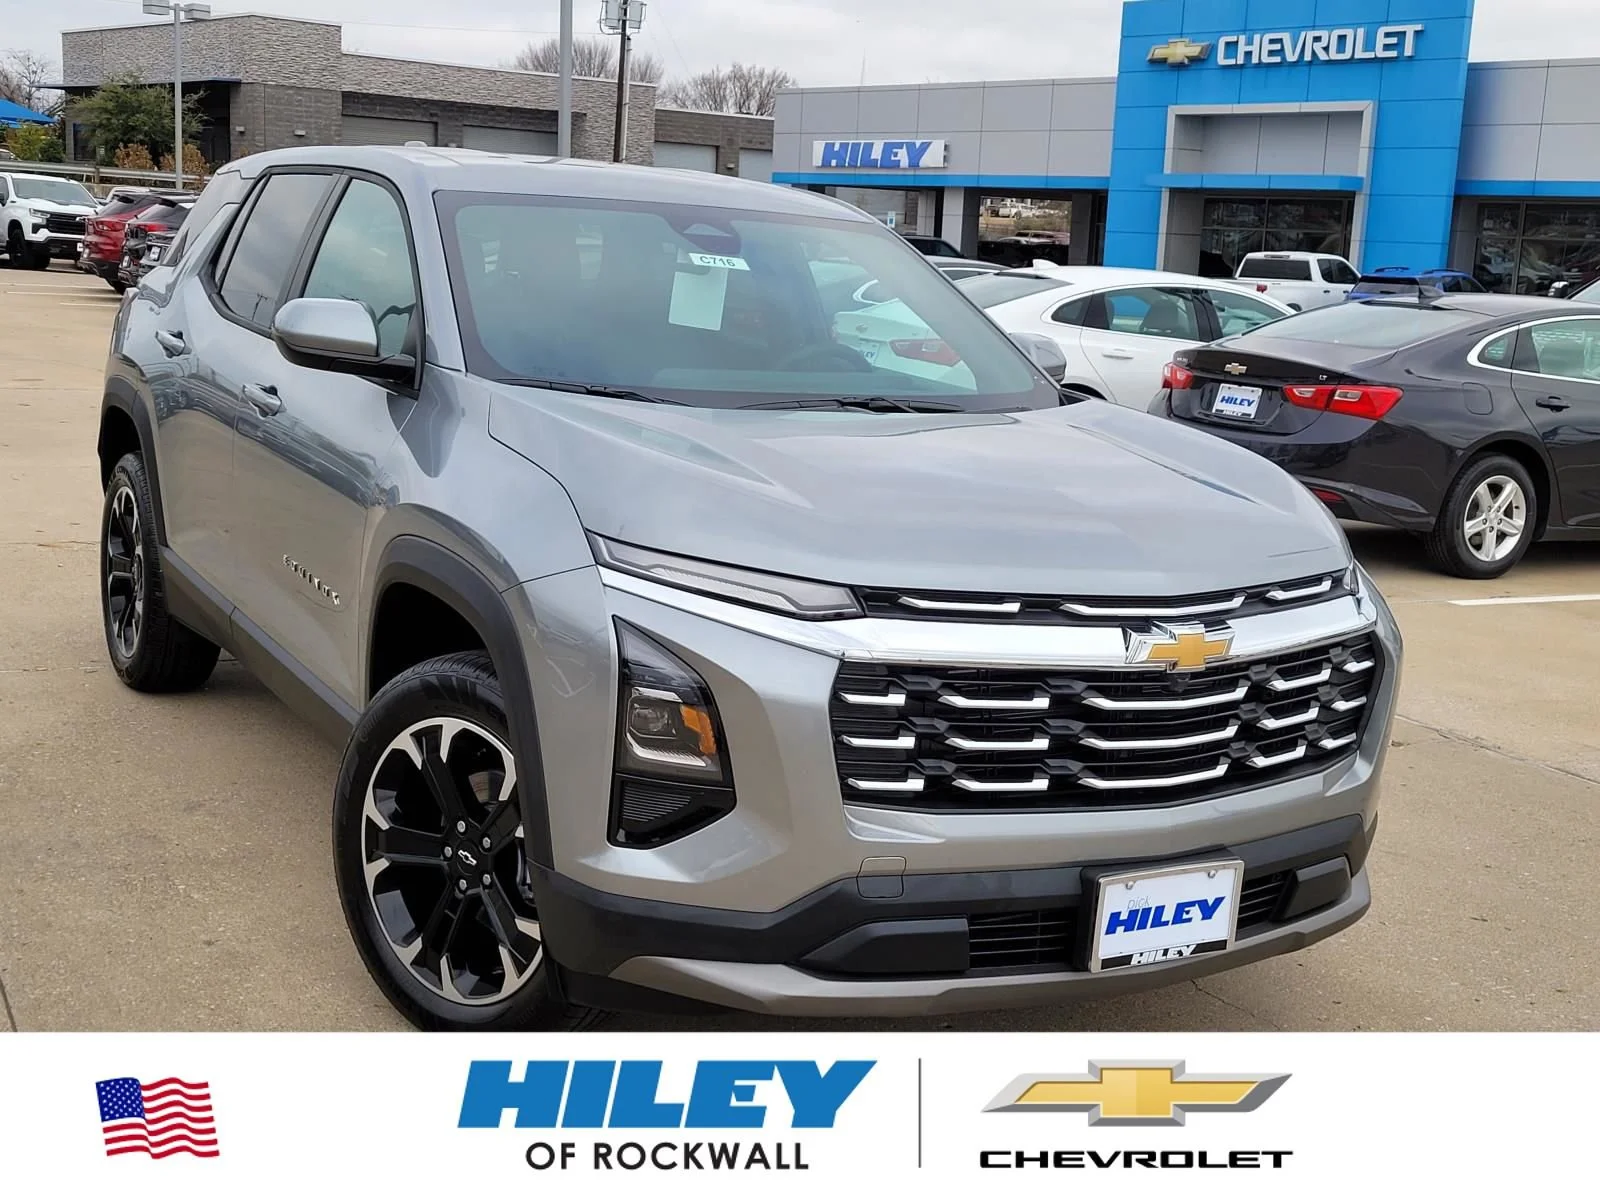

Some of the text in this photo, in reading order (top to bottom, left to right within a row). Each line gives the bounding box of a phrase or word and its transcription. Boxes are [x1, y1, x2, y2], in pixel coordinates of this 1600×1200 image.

[1217, 23, 1424, 66] CHEVROLET
[821, 141, 933, 168] HILEY
[700, 255, 736, 267] C716
[1220, 395, 1255, 407] HILEY
[1104, 896, 1226, 936] HILEY
[1130, 944, 1197, 965] HILEY
